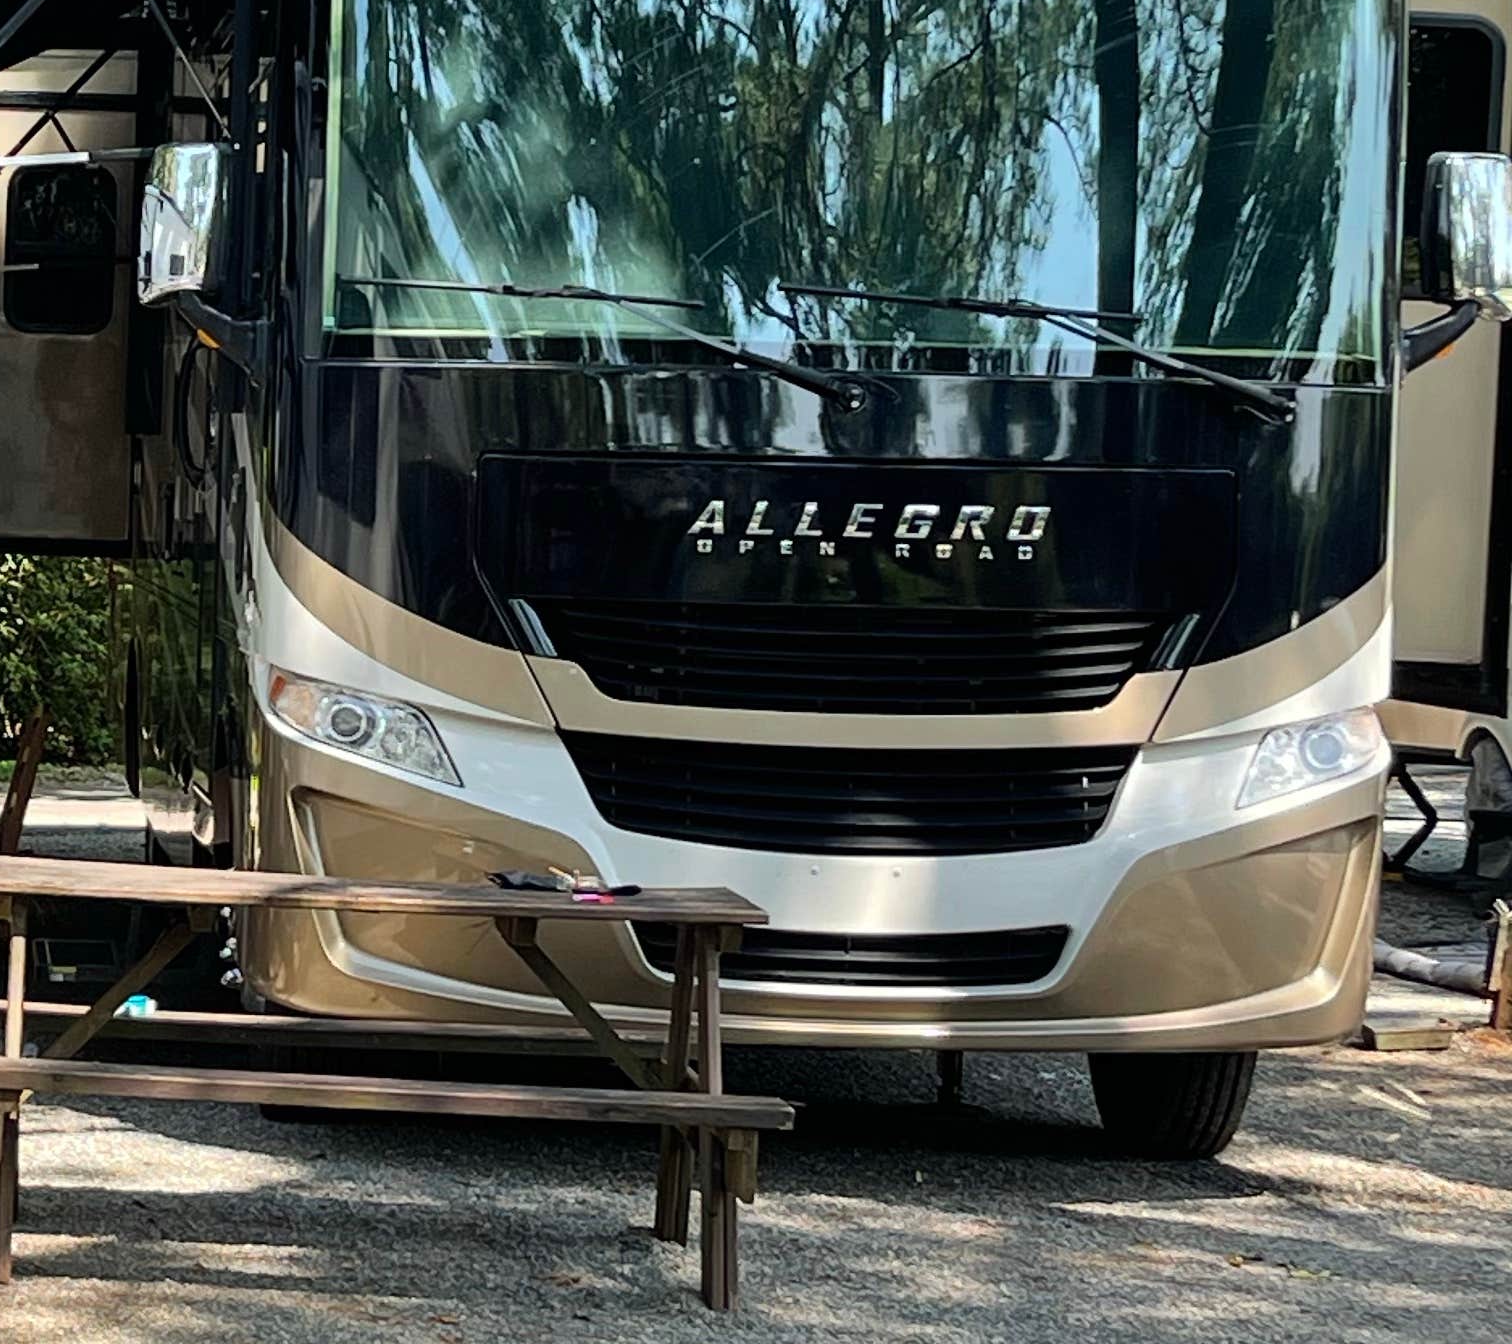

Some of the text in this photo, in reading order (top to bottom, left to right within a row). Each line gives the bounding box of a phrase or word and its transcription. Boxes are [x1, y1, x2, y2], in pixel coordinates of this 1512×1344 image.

[687, 500, 1051, 540] ALLEGRO
[696, 539, 1033, 560] OPEN ROAD
